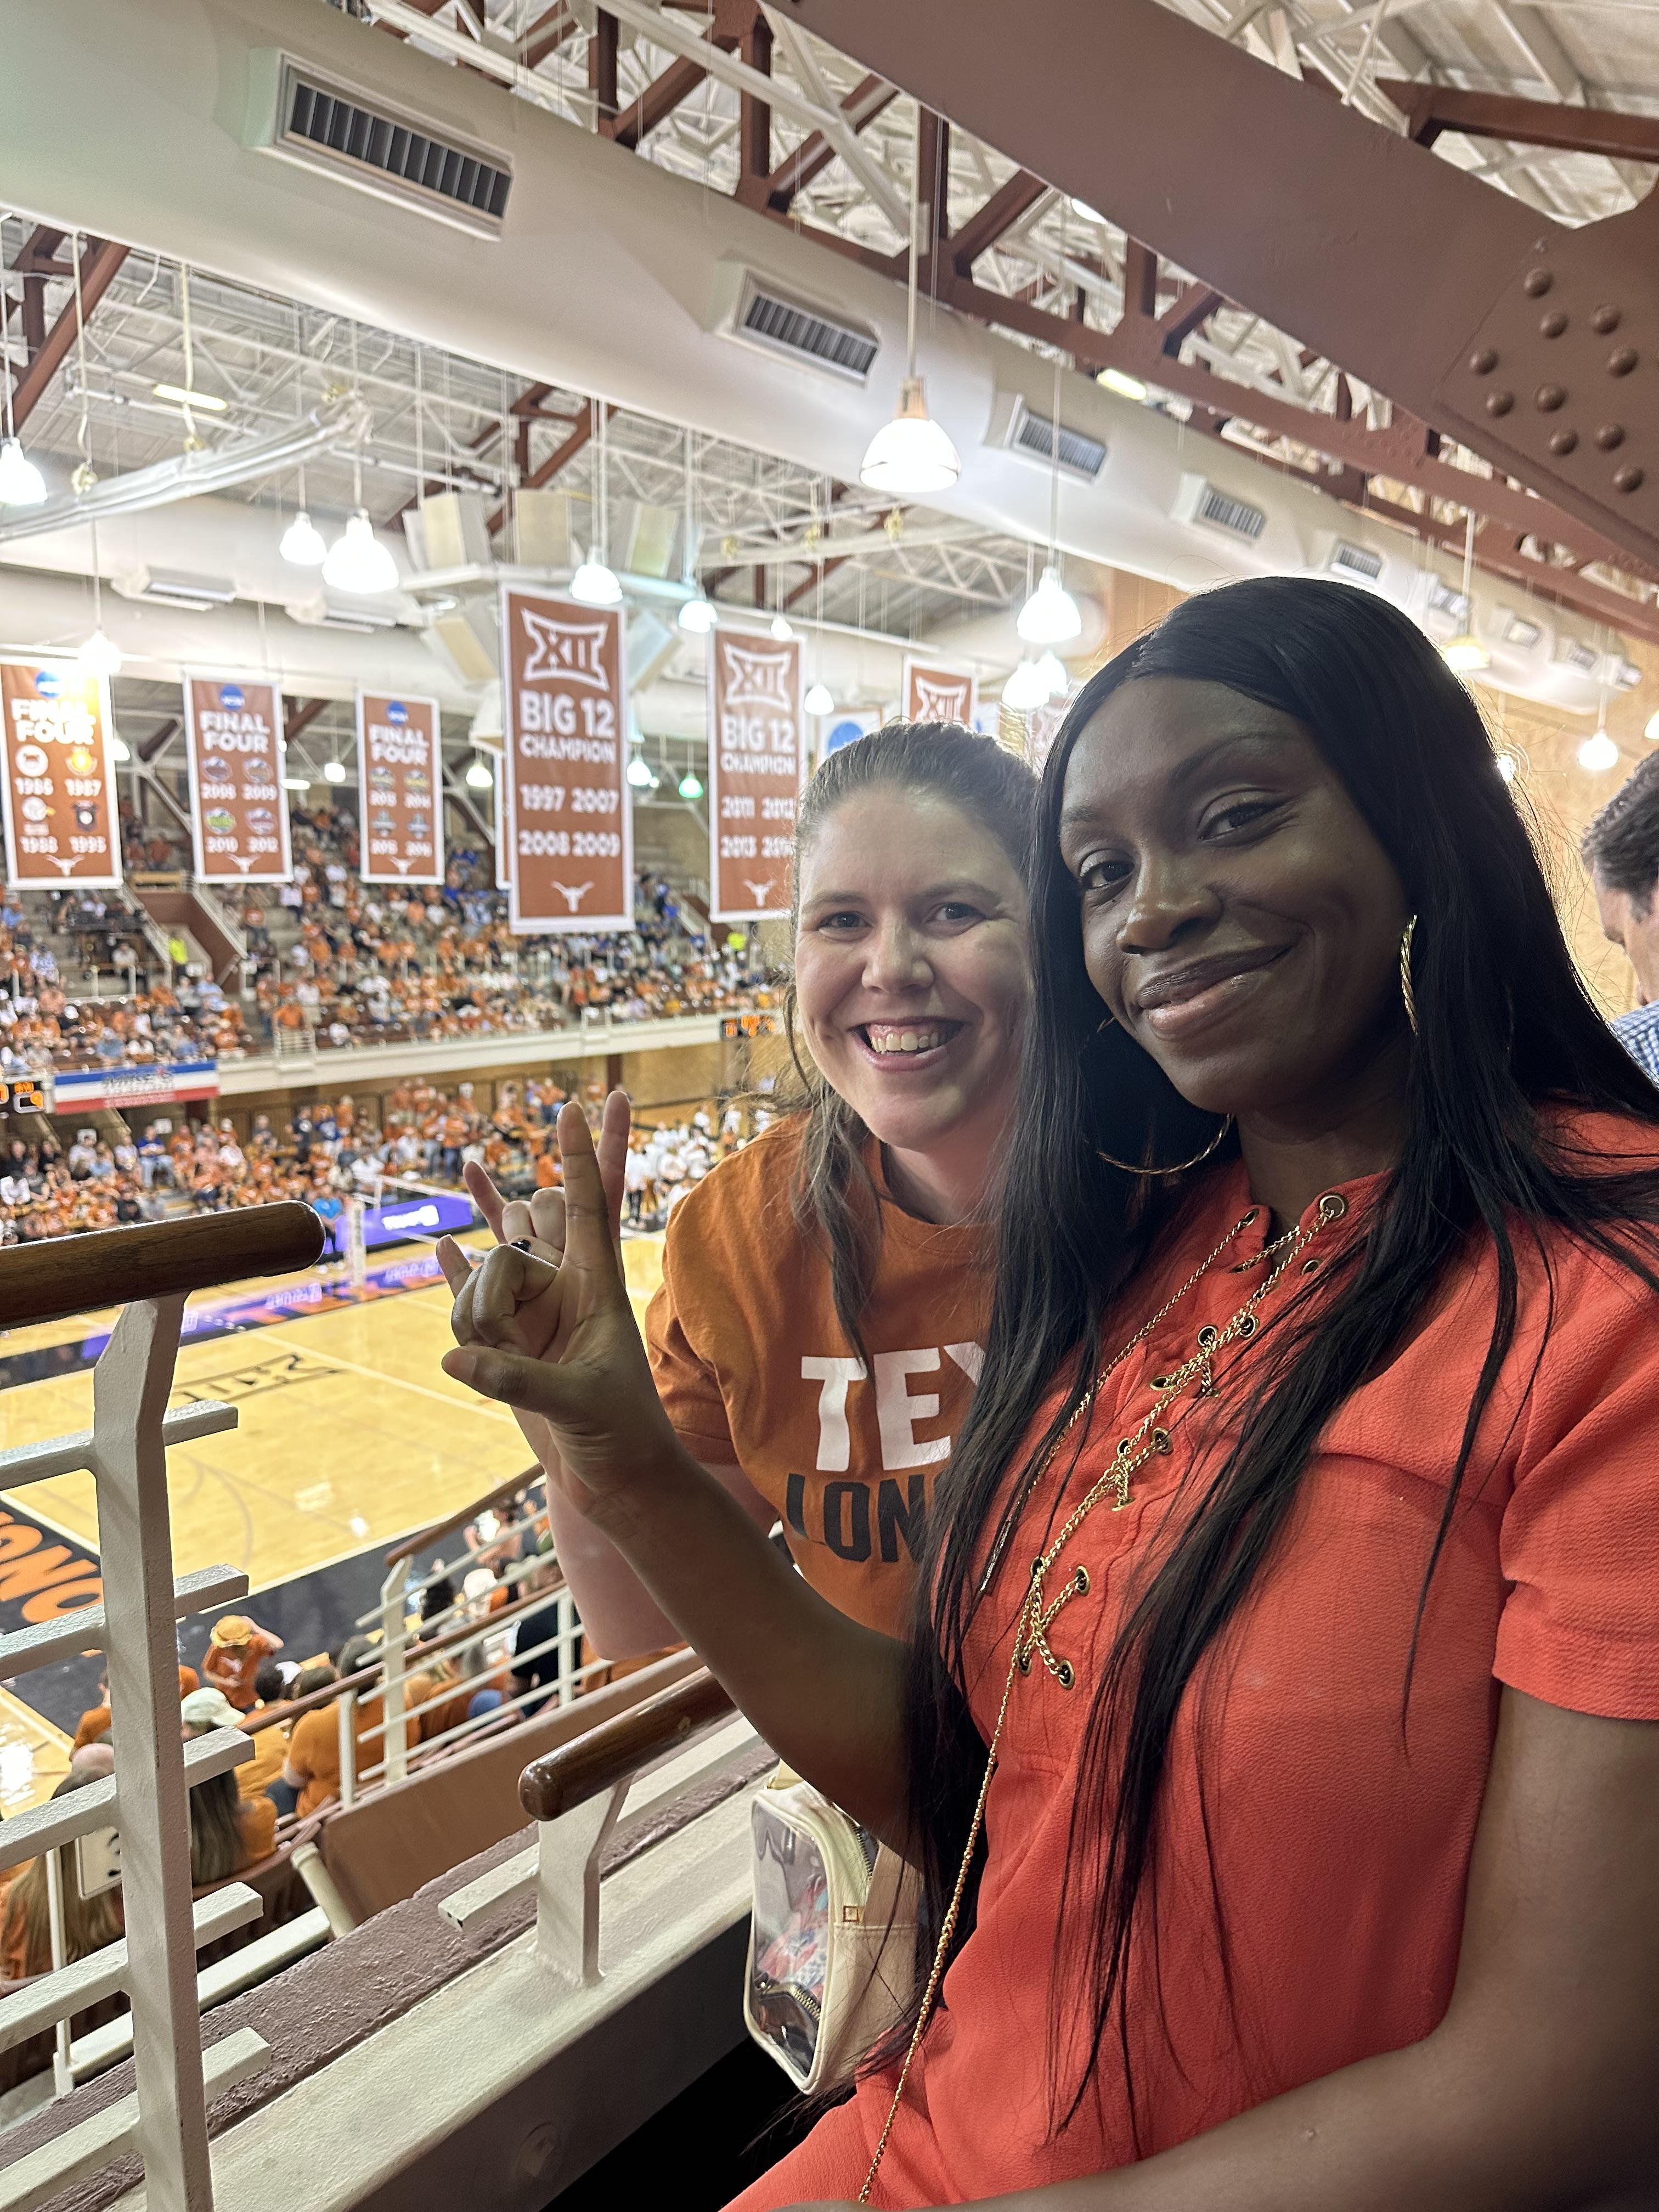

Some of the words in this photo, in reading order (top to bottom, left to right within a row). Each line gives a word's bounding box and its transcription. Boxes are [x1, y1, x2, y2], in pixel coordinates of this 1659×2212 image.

[200, 710, 270, 734] FINAL
[520, 690, 576, 736] BIG
[580, 696, 616, 739] 12
[16, 720, 94, 745] FOUR
[203, 730, 269, 753] FOUR
[369, 723, 430, 748] FINAL
[721, 714, 765, 752] BIG
[770, 718, 795, 754] 12
[371, 742, 427, 766] FOUR
[519, 733, 617, 764] CHAMPION
[520, 783, 566, 812] 1997
[571, 786, 619, 814] 2007
[519, 829, 570, 857] 2008
[572, 831, 620, 858] 2009
[786, 1473, 945, 1562] LON
